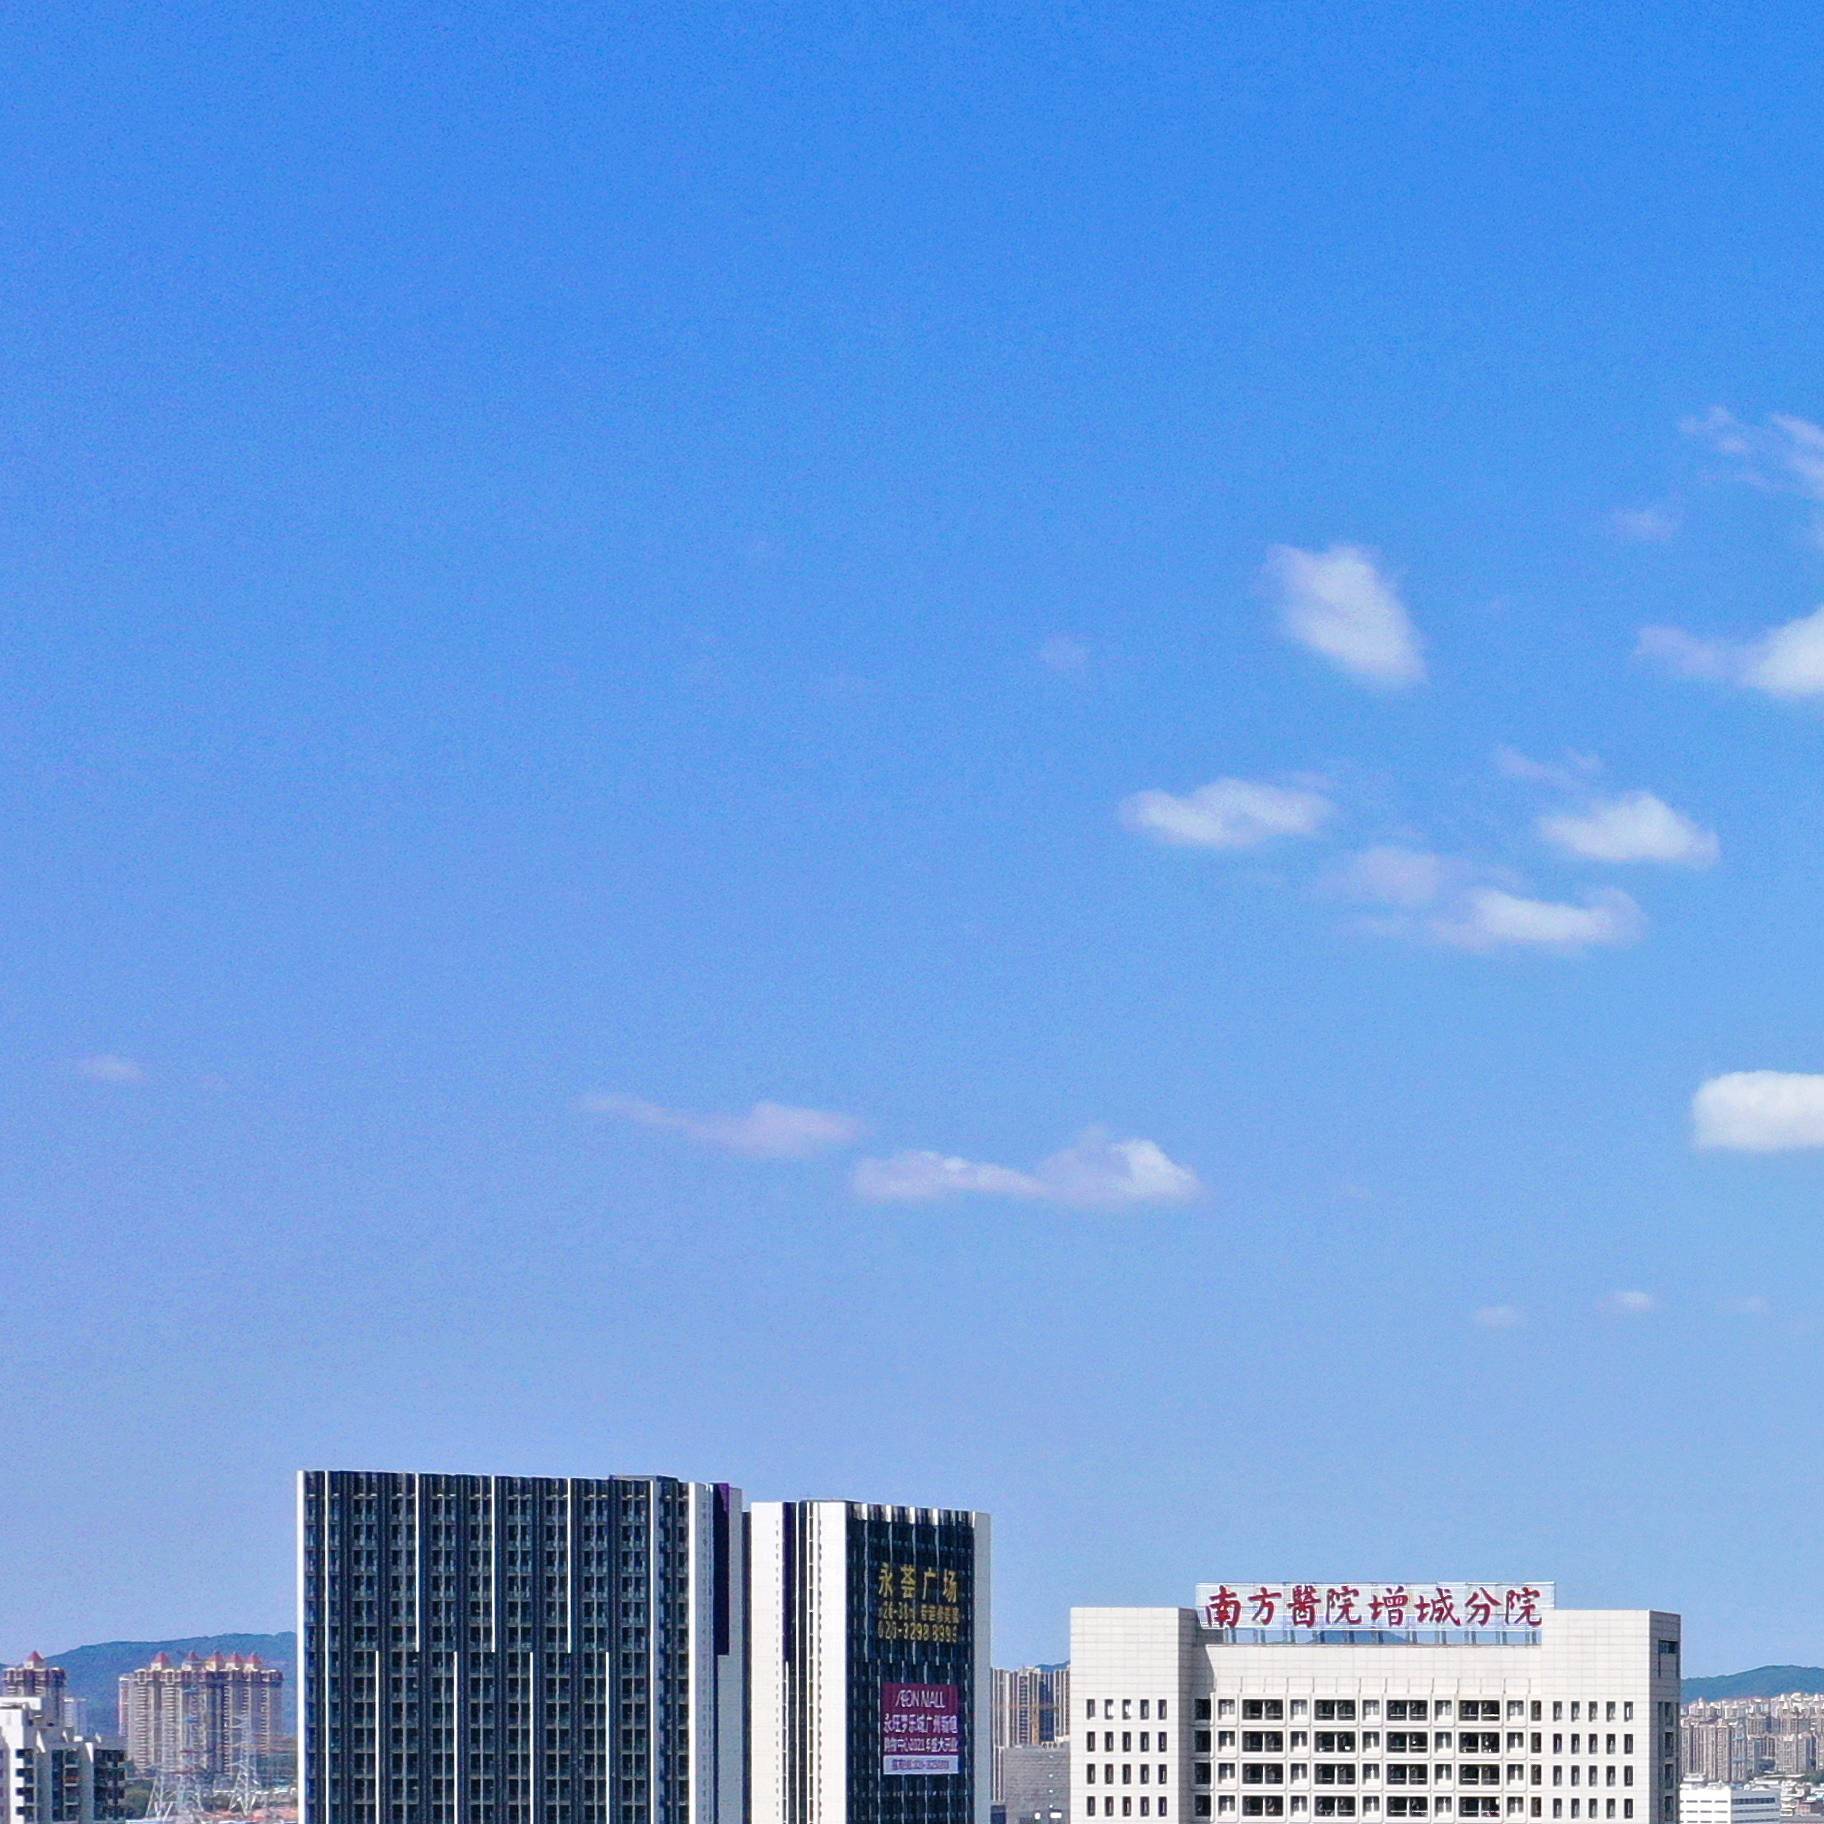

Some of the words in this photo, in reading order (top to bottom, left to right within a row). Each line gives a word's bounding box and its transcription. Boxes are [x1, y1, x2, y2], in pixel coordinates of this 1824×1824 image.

[1205, 1585, 1543, 1628] 南方醫院增城分院
